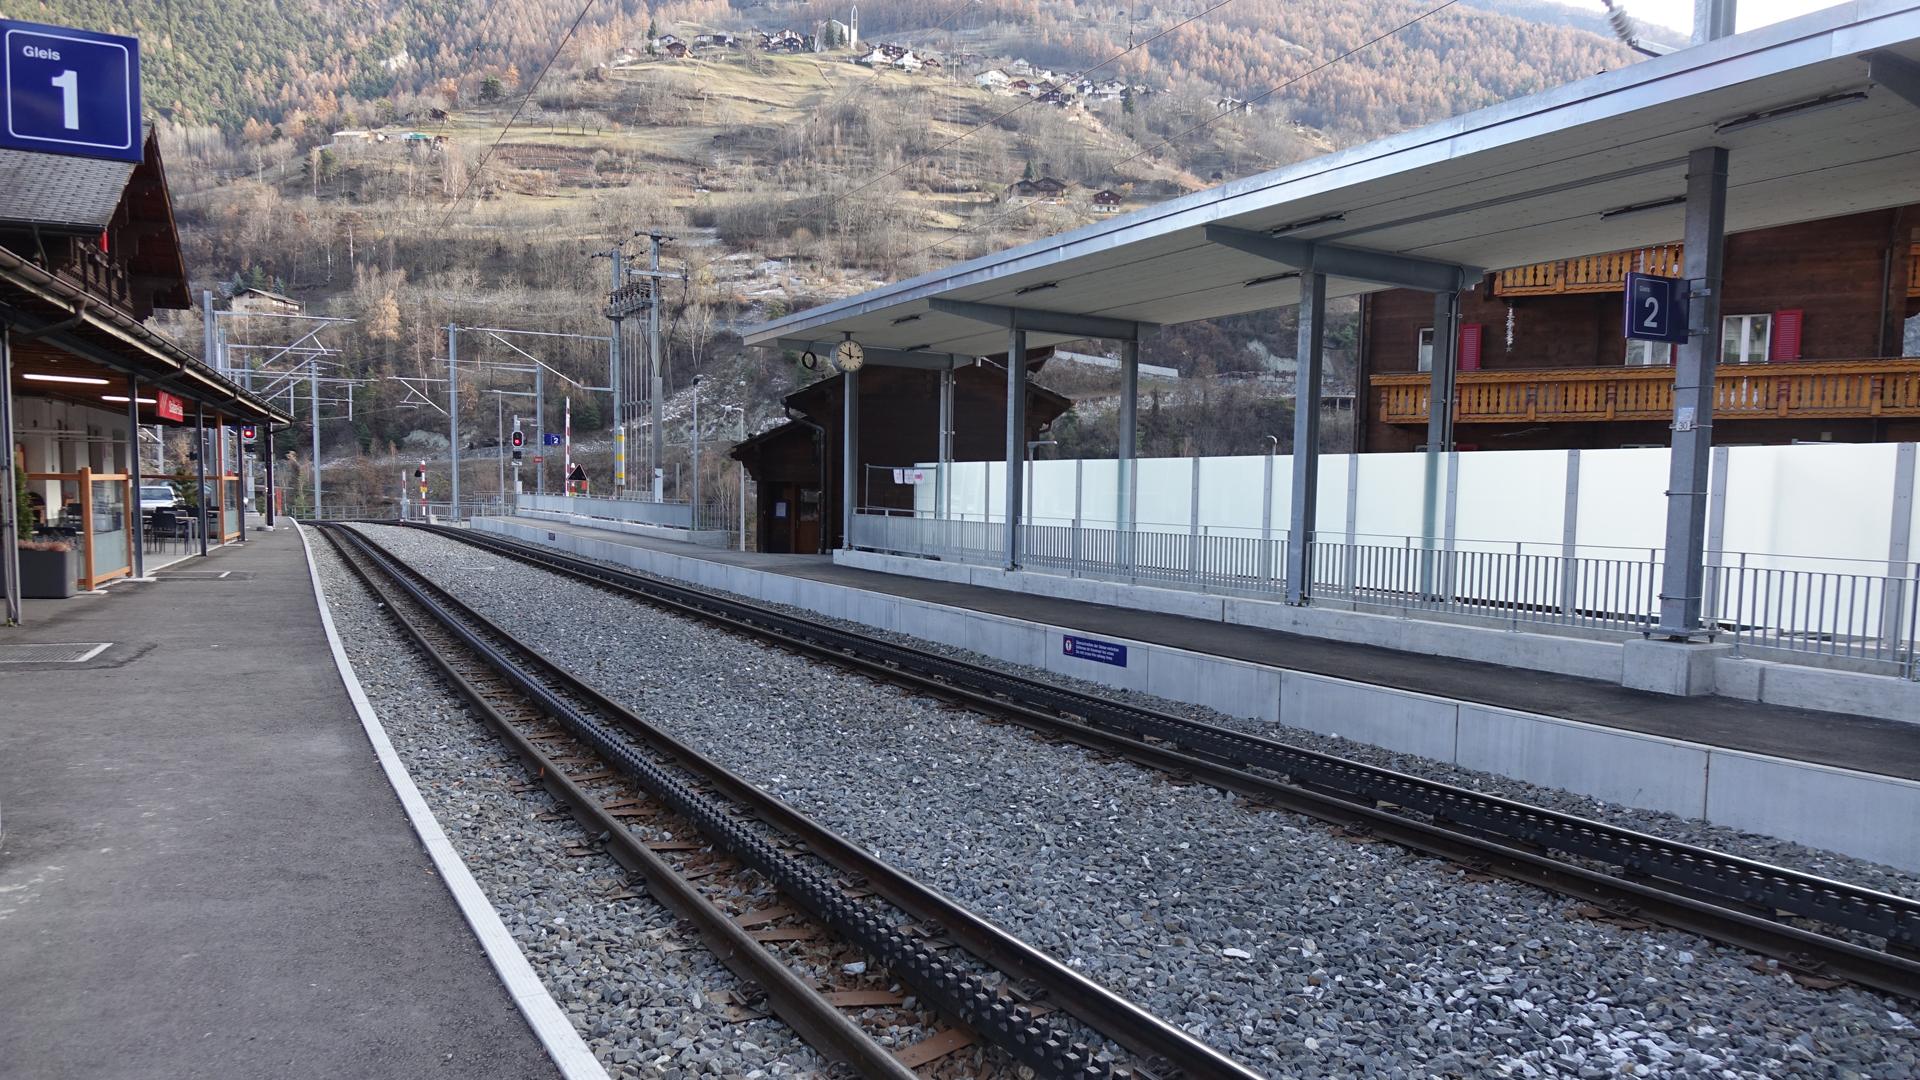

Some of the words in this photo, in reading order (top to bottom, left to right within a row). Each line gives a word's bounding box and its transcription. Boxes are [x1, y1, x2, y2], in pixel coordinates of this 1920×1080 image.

[23, 45, 61, 61] Gleis
[51, 69, 80, 131] 1
[1643, 296, 1659, 328] 2
